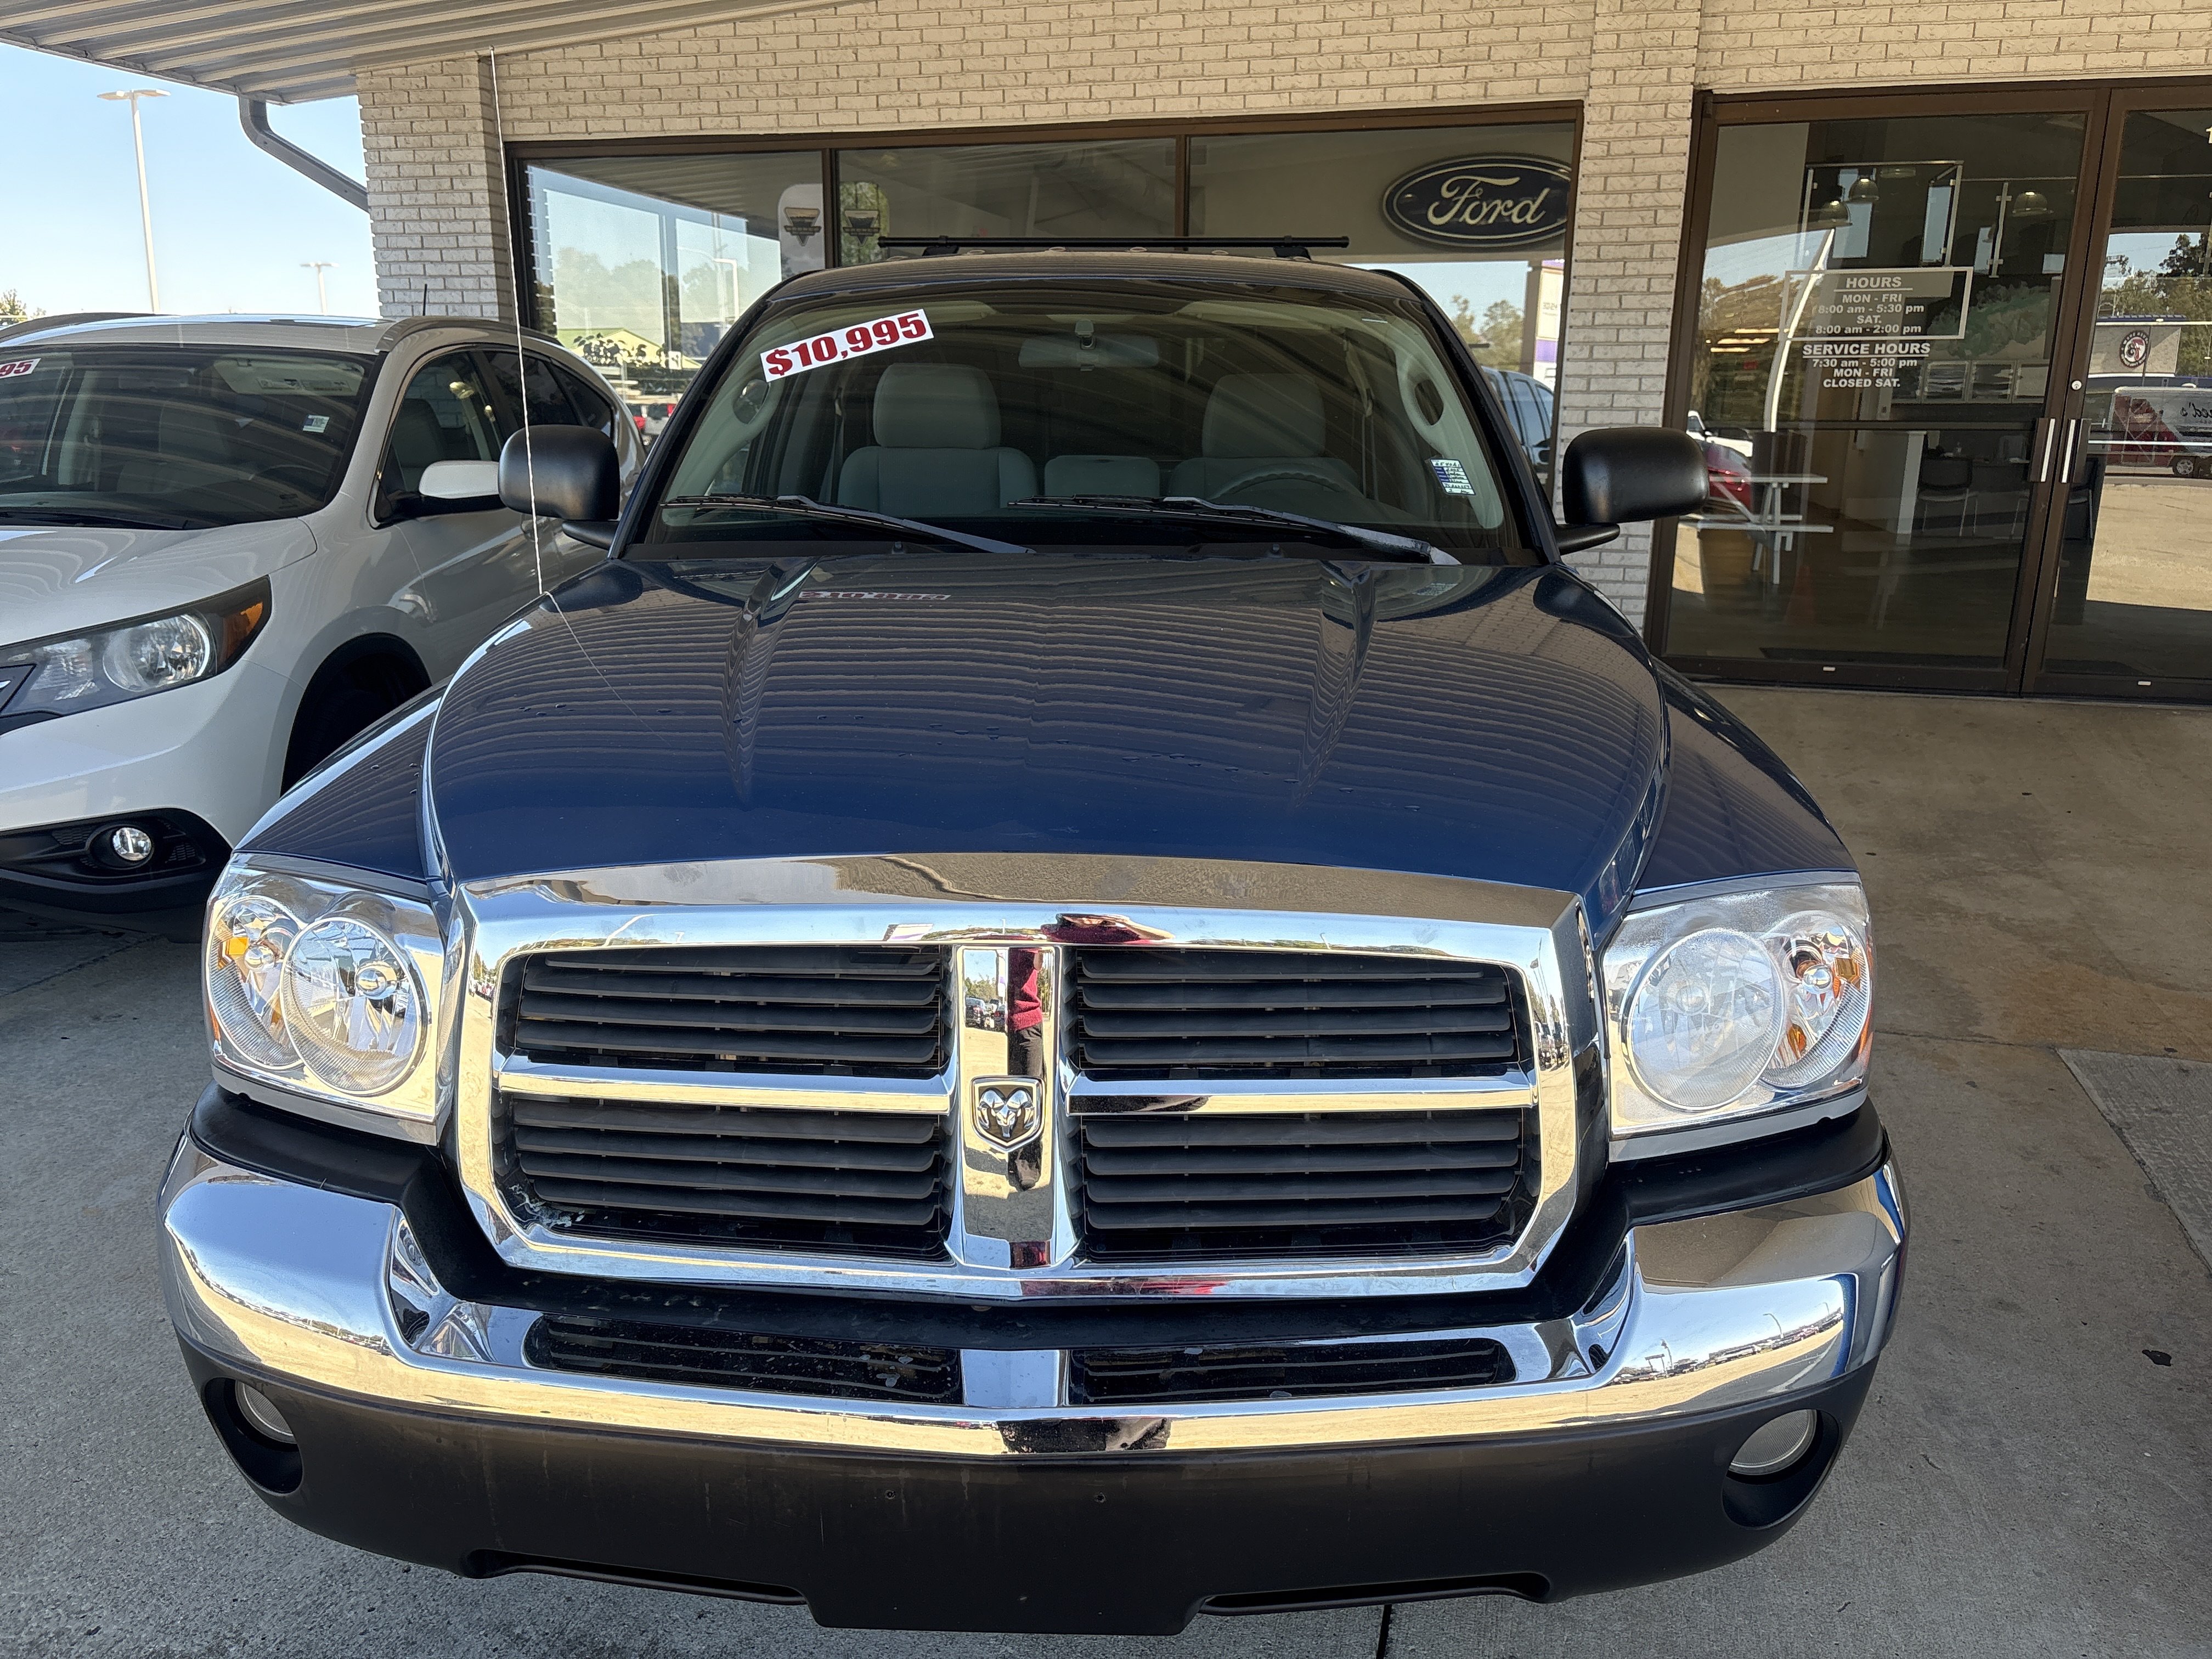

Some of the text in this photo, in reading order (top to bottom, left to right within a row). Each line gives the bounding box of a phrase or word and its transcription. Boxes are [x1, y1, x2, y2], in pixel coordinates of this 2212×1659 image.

[1427, 175, 1550, 225] Ford
[1846, 277, 1902, 288] HOURS
[1842, 294, 1871, 303] MON
[1882, 294, 1902, 302] FRI
[1818, 304, 1843, 313] 8:00
[1876, 304, 1902, 312] 5:30
[1905, 305, 1924, 314] pm
[1857, 315, 1882, 324] SAT.
[1815, 325, 1841, 334] 8:00
[1873, 325, 1899, 333] 2:00
[1903, 325, 1921, 335] pm
[766, 313, 927, 376] $10,995
[1803, 343, 1930, 355] SERVICE HOURS
[1813, 359, 1837, 368] 7:30
[1870, 358, 1895, 366] 5:00
[1899, 359, 1917, 368] pm
[1833, 369, 1861, 377] MON
[1873, 368, 1893, 376] FRI
[1823, 379, 1900, 387] CLOSED SAT.
